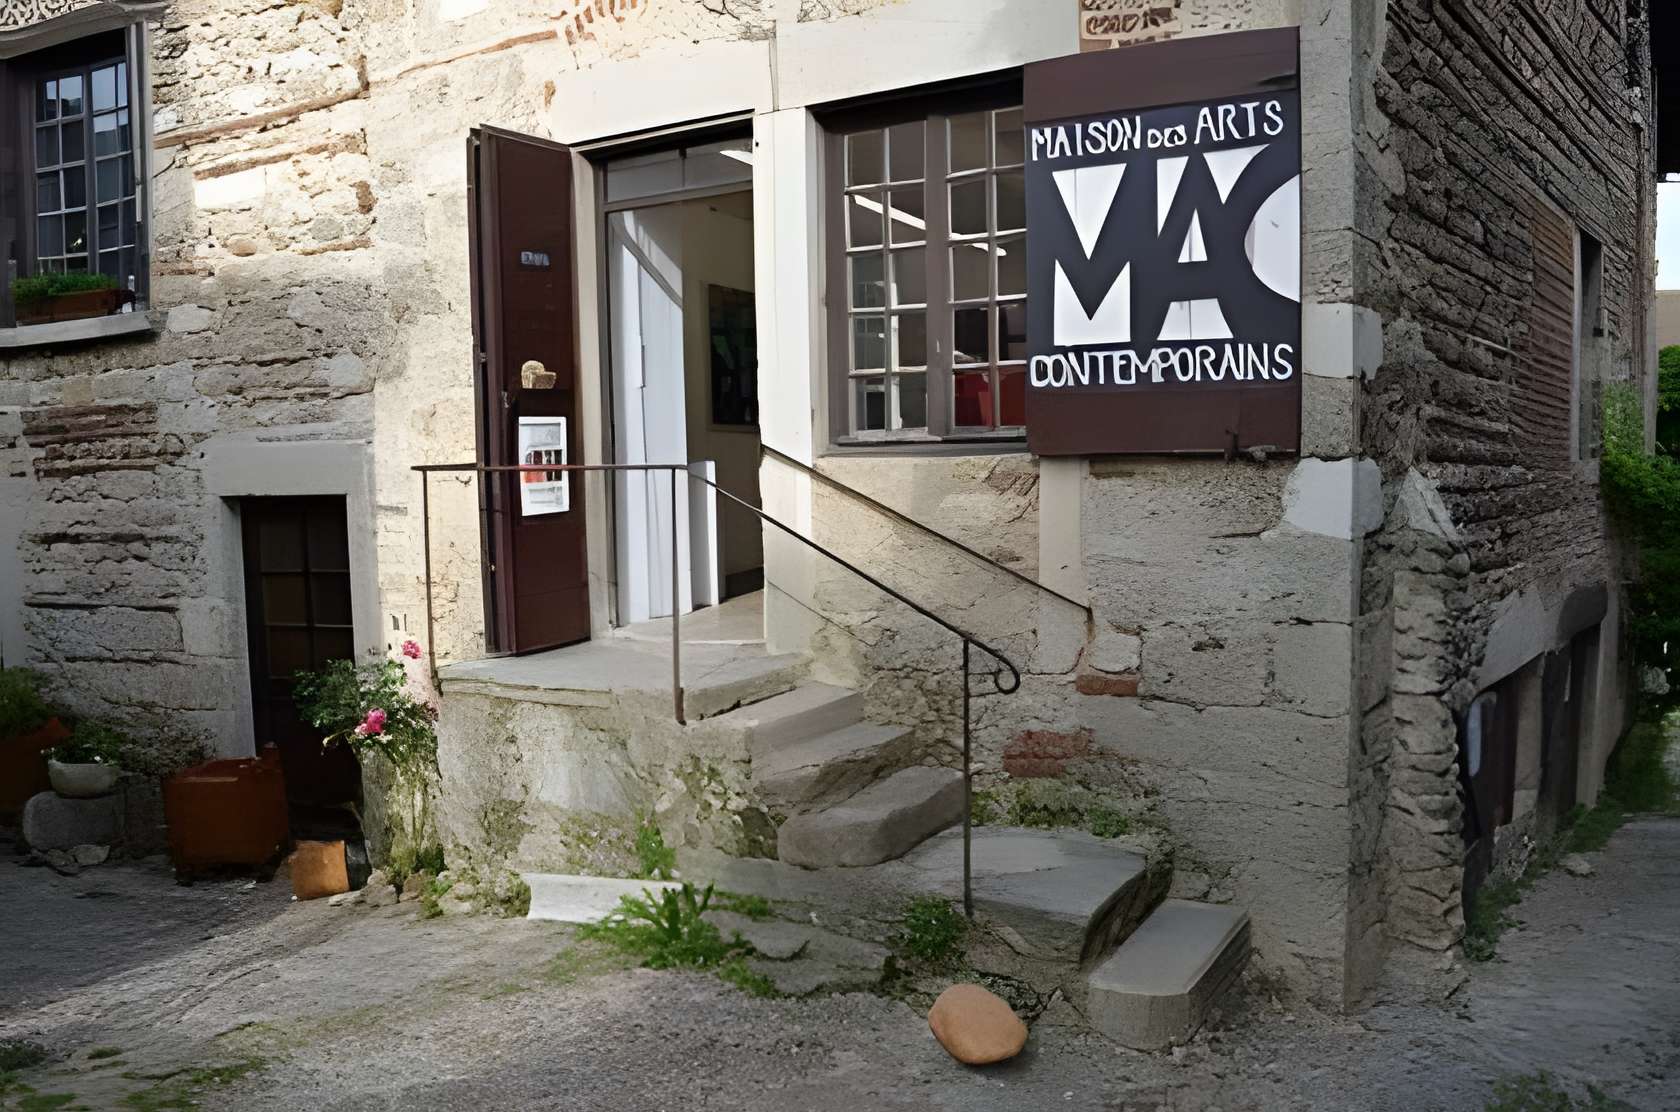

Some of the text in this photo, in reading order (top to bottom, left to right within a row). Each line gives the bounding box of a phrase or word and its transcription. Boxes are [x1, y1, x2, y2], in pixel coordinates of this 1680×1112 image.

[1031, 115, 1141, 161] MAISON
[1194, 100, 1285, 145] ARTS
[1030, 343, 1294, 388] CONTEMPORAINS
